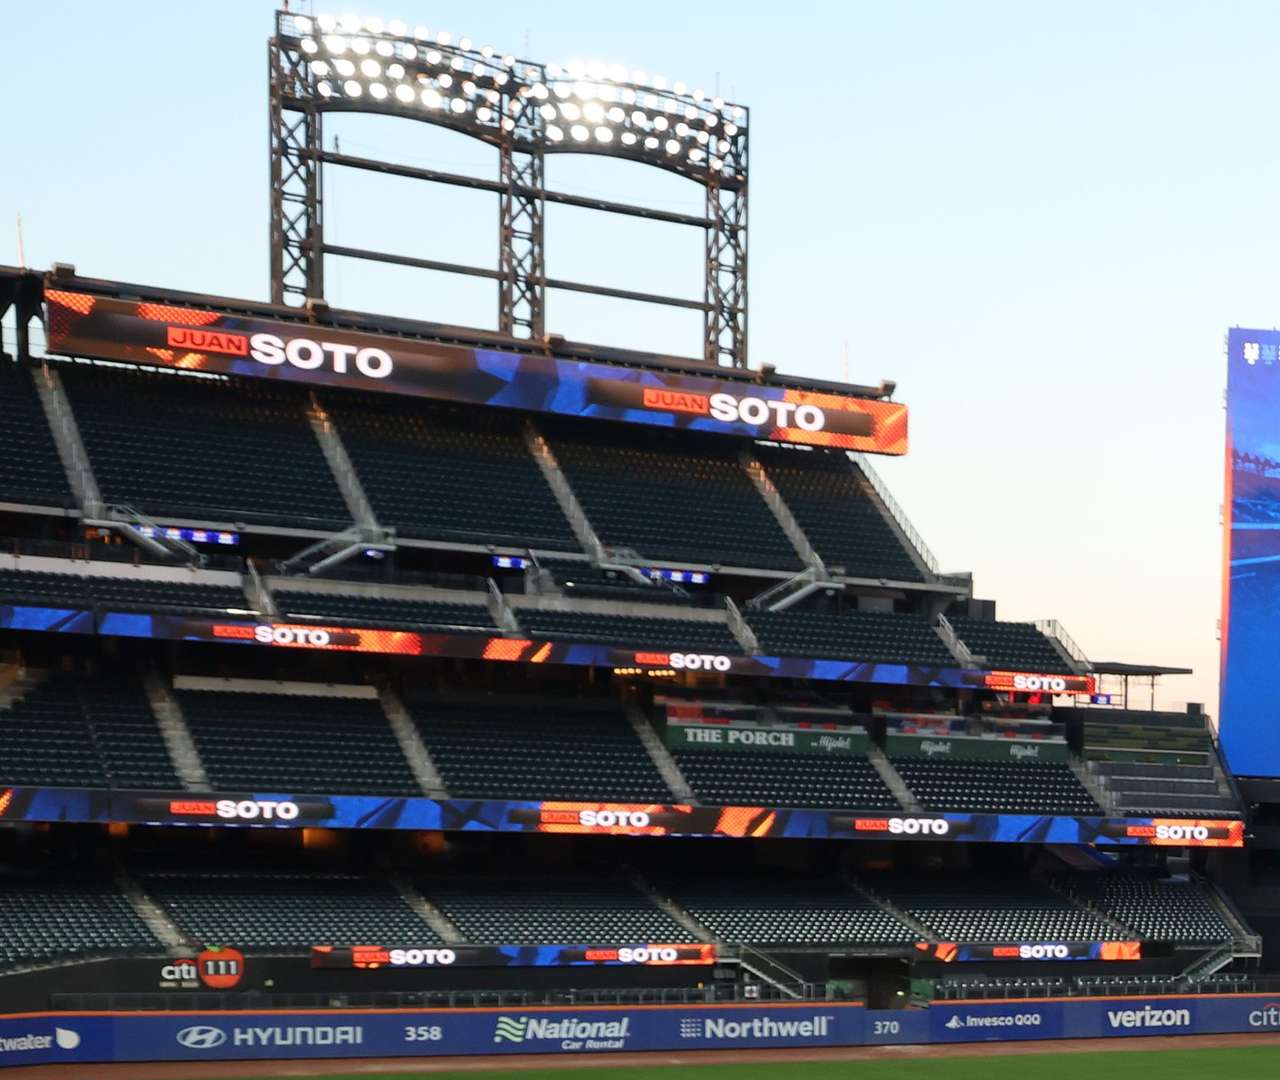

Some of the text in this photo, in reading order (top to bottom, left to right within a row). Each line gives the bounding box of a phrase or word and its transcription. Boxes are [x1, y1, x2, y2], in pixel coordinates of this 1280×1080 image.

[172, 330, 394, 379] JUAN SOTO
[647, 391, 826, 432] JUAN SOTO
[254, 625, 331, 646] SOTO
[668, 652, 732, 672] SOTO
[1013, 675, 1066, 691] SOTO
[684, 727, 796, 747] THE PORCH
[216, 799, 299, 820] SOTO
[578, 810, 650, 828] SOTO
[888, 817, 949, 835] SOTO
[1155, 825, 1209, 841] SOTO
[389, 949, 456, 965] SOTO
[618, 947, 678, 963] SOTO
[1019, 944, 1069, 959] SOTO
[161, 959, 238, 980] citi 111
[965, 1013, 1041, 1028] Invesco QQQ
[1107, 1005, 1191, 1028] verizon
[233, 1025, 363, 1047] HYUNDAI
[404, 1025, 442, 1042] 358
[525, 1017, 630, 1040] National
[704, 1015, 828, 1039] Northwell
[872, 1020, 899, 1036] 370
[561, 1037, 624, 1051] Car Rental
